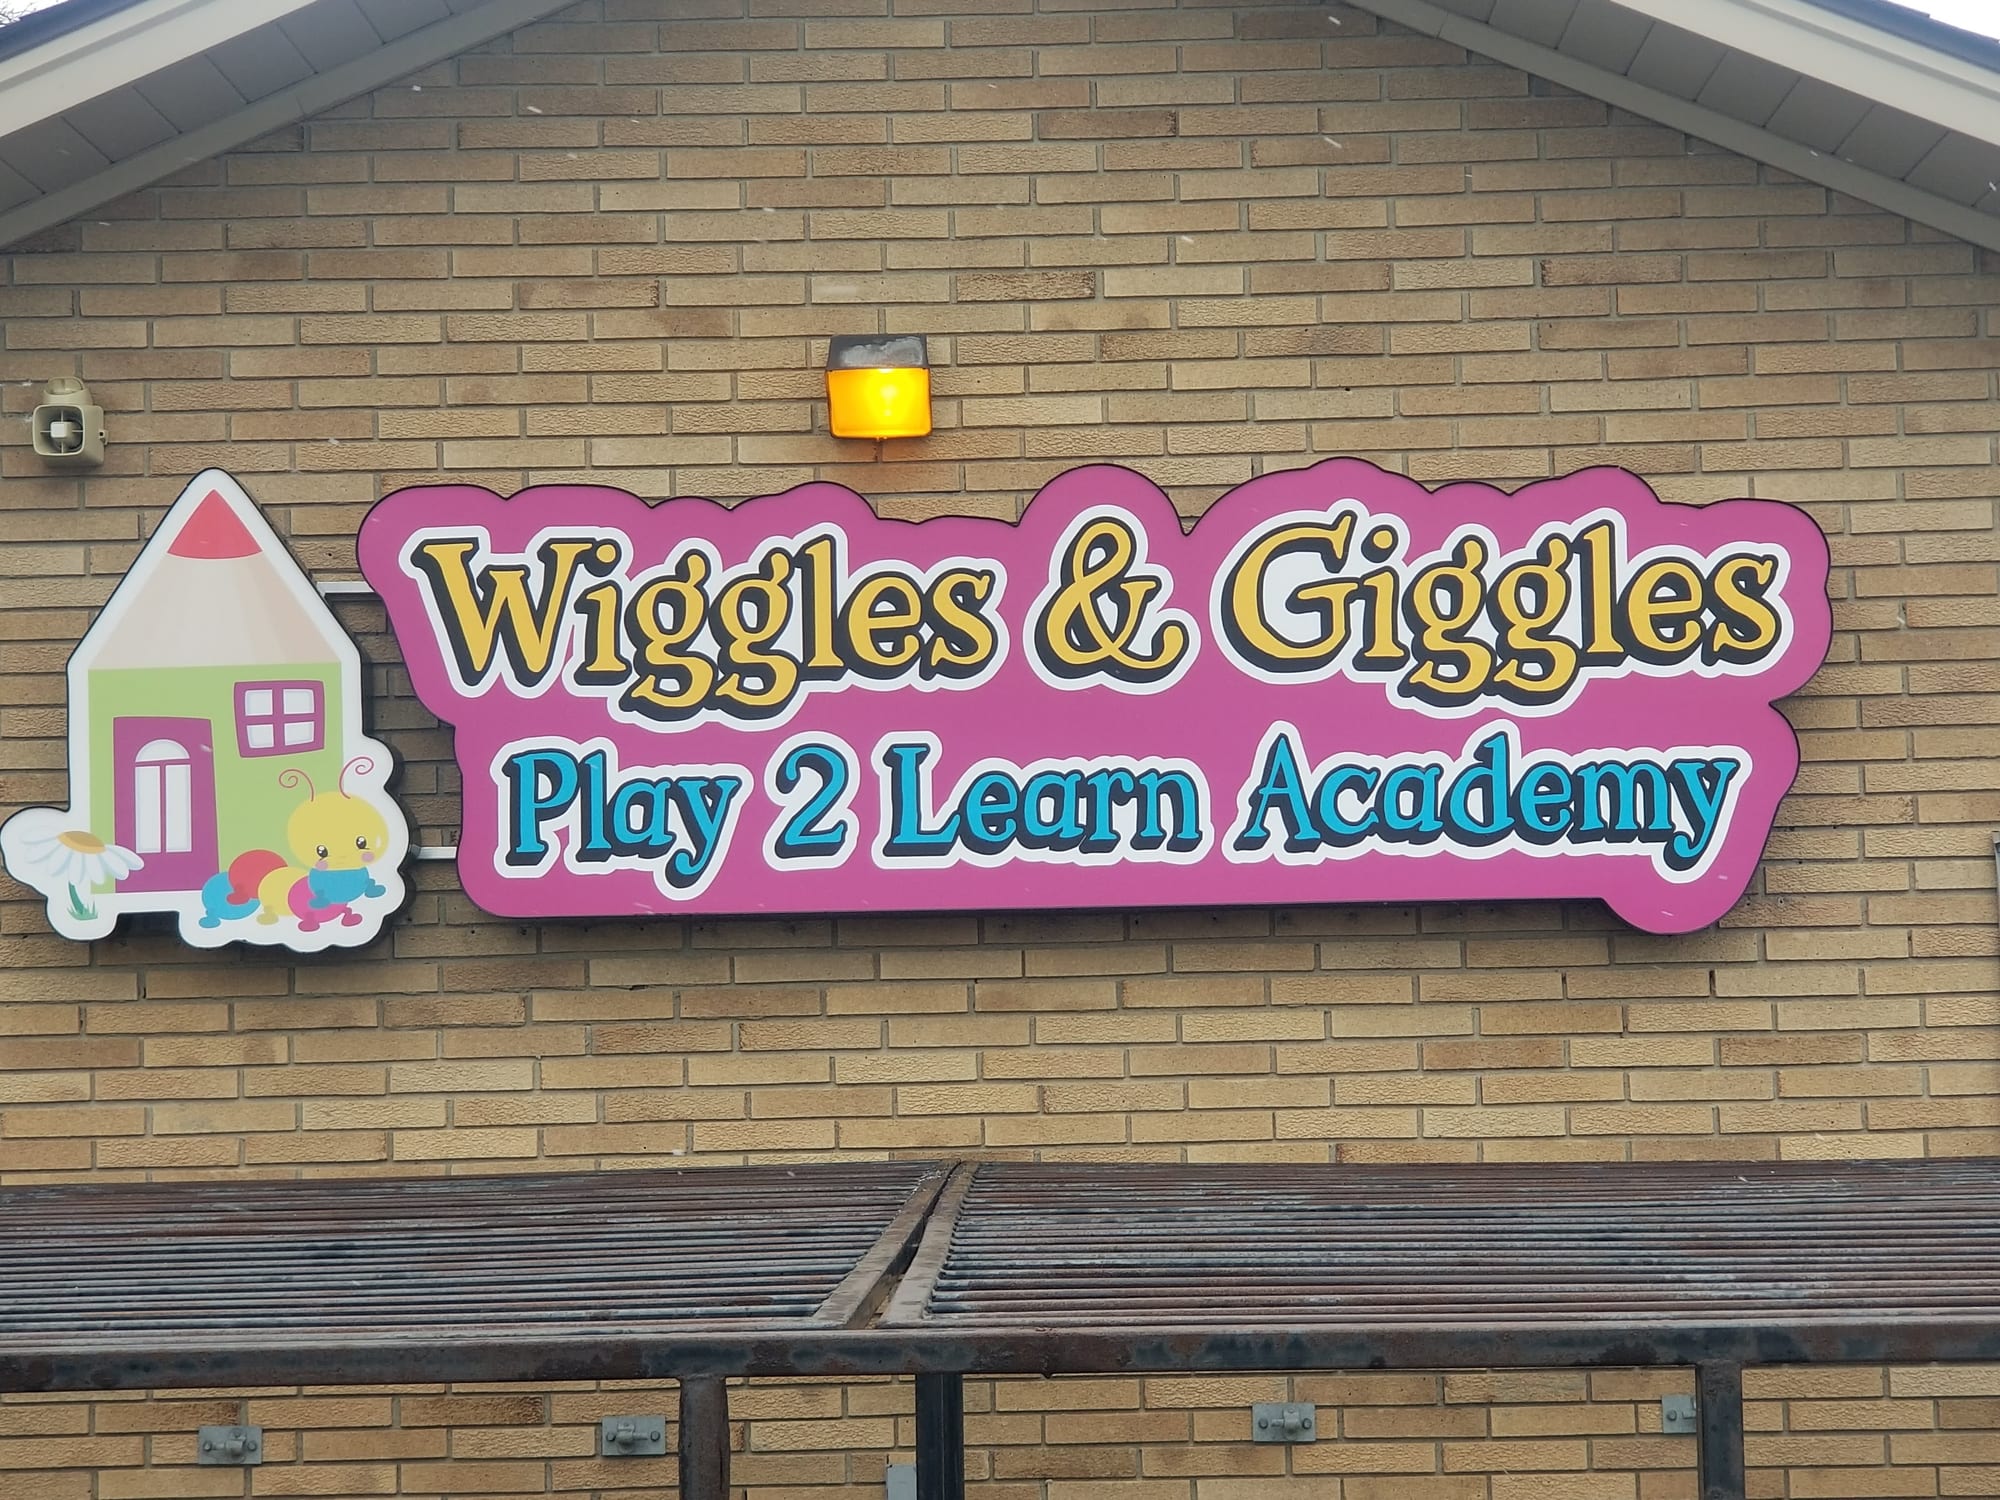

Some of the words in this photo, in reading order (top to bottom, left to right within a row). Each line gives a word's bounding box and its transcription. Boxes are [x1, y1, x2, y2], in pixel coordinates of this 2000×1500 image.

[410, 531, 996, 720] Wiggles
[1034, 515, 1189, 682] &
[1222, 510, 1782, 705] Giggles
[501, 748, 742, 888] Play
[774, 743, 850, 859] 2
[882, 743, 1203, 858] Learn
[1234, 731, 1740, 871] Academy
